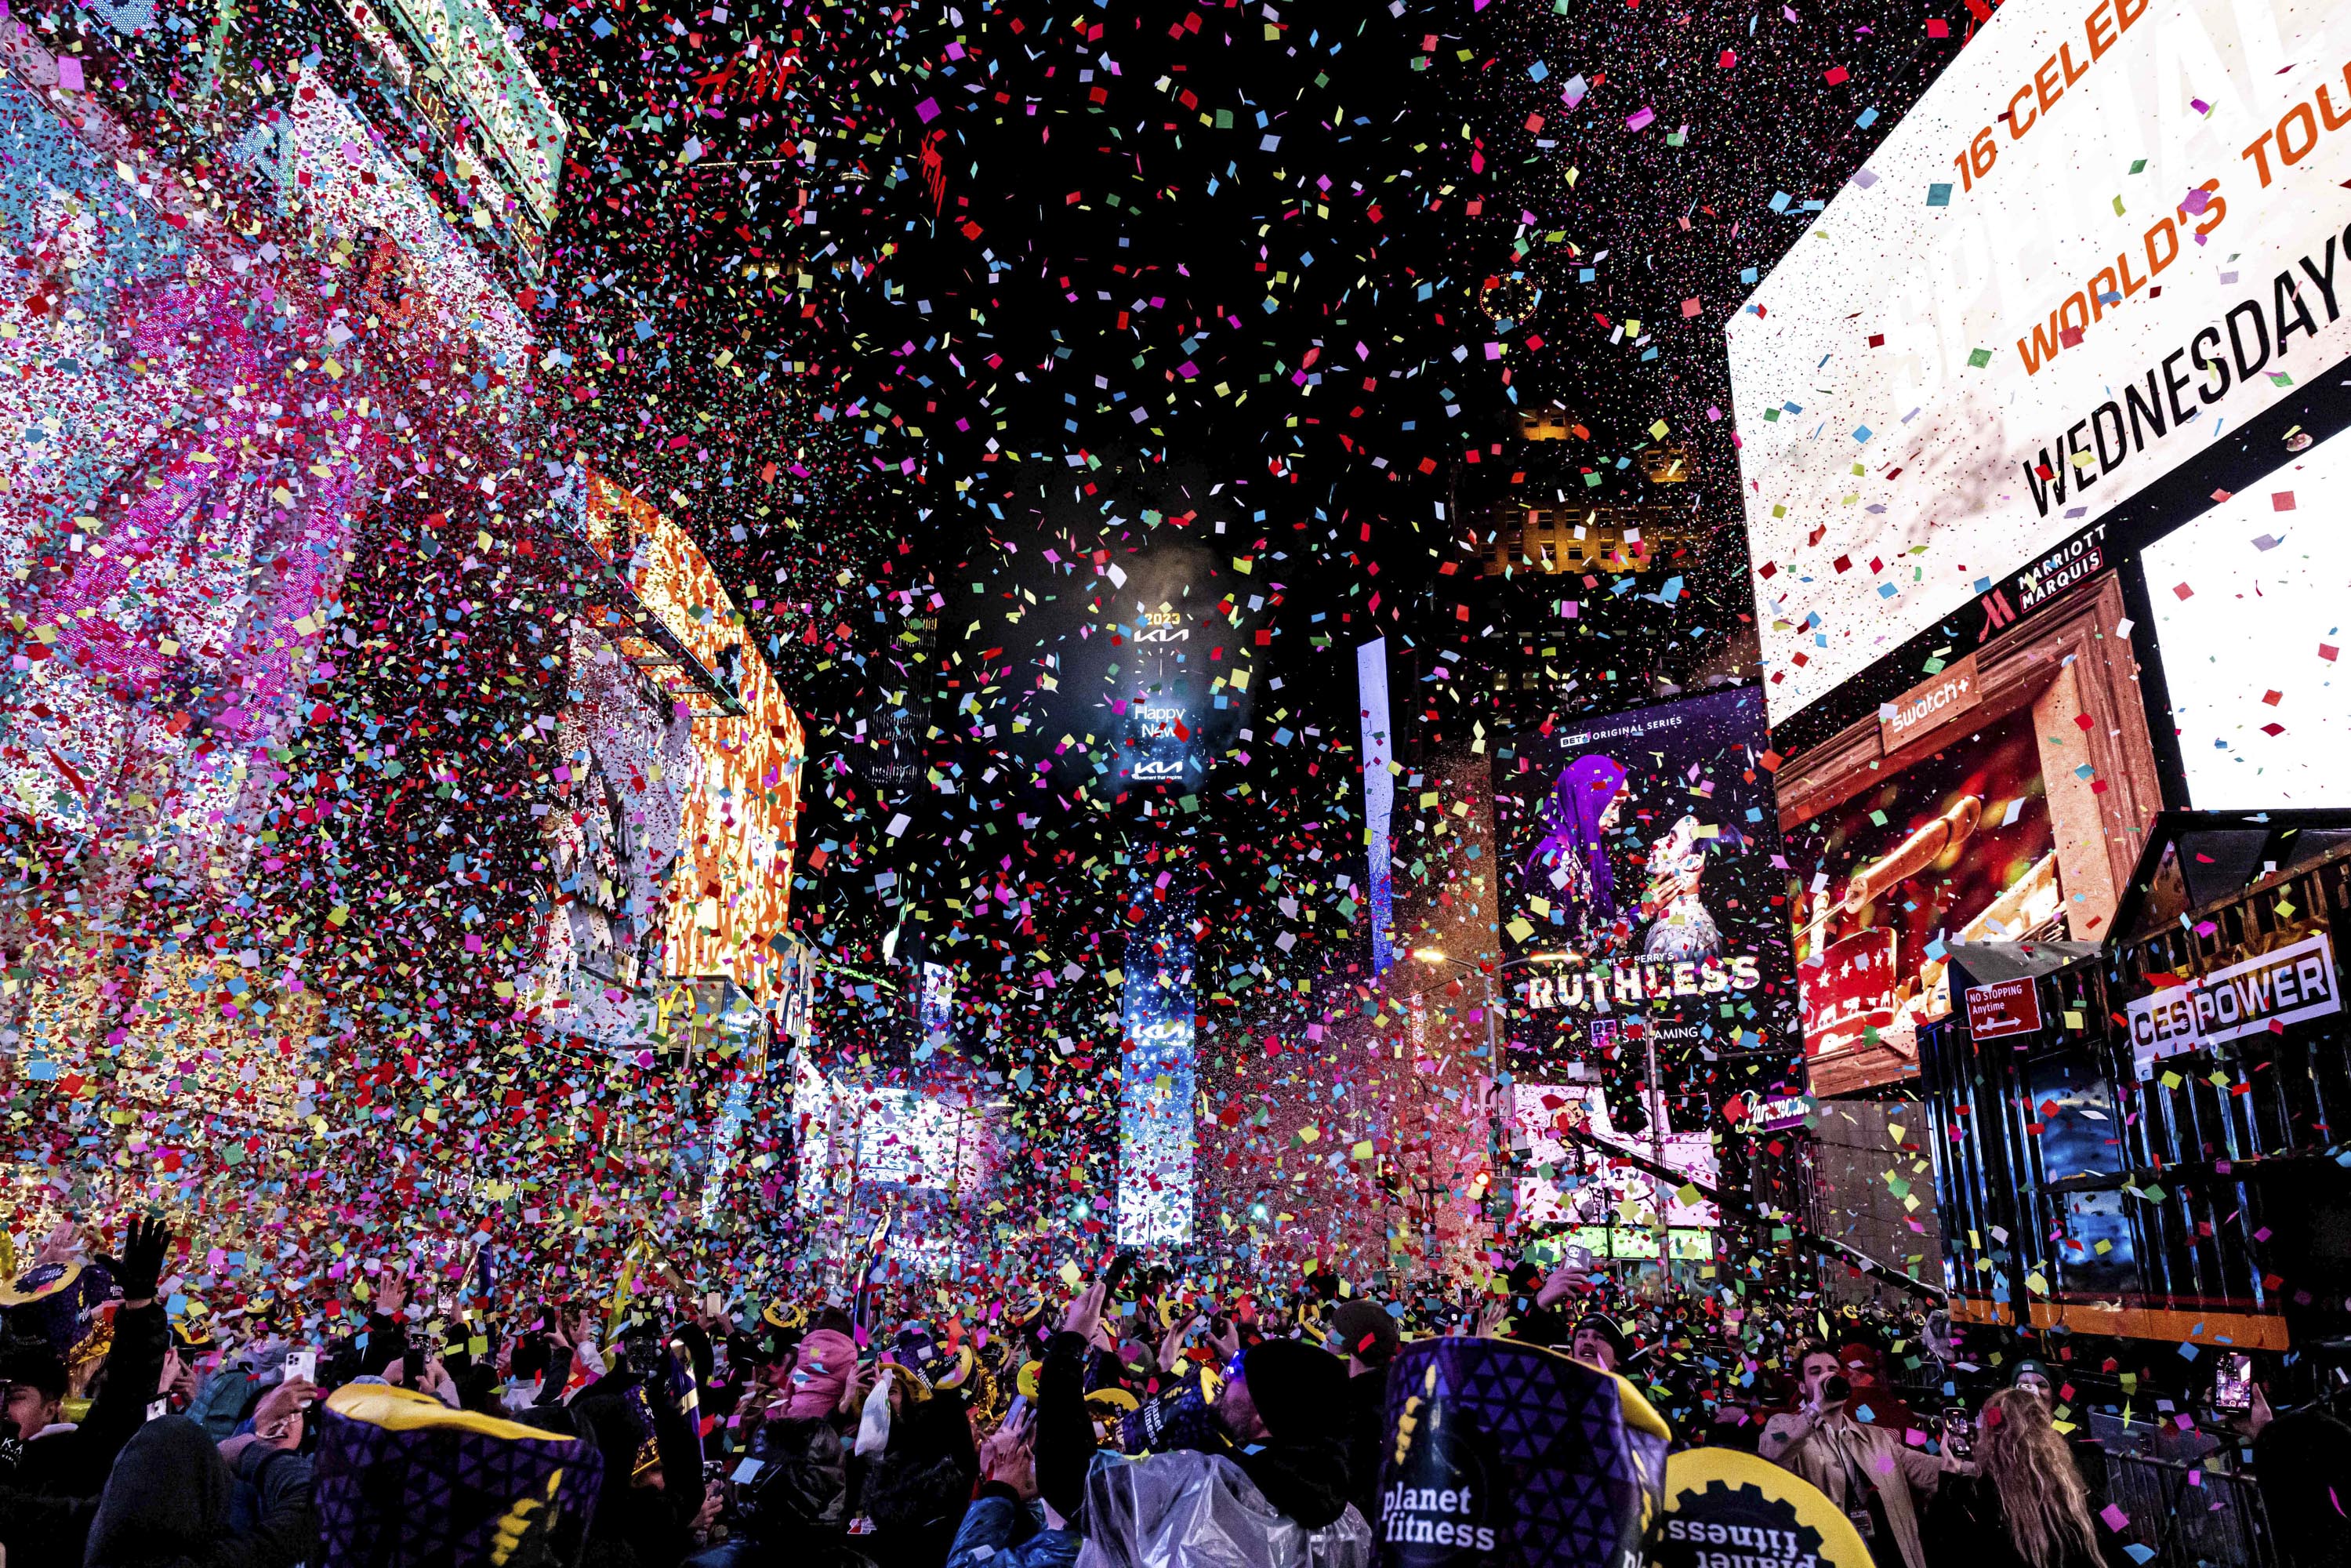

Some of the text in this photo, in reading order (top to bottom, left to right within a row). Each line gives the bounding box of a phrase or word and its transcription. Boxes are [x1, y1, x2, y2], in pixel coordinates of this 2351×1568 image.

[1954, 125, 1997, 194] 16
[2016, 178, 2226, 377] WORLD'S
[2022, 552, 2100, 610] MARQUIS
[1145, 612, 1181, 626] 2023
[1134, 705, 1187, 723] Happy
[1141, 723, 1176, 738] New
[1592, 724, 1643, 740] ORIGINAL
[1647, 716, 1682, 730] SERIES
[1634, 952, 1674, 964] PERRY'S
[1529, 956, 1761, 1009] RUTHLESS
[1969, 985, 2023, 1003] NO STOPPING
[1972, 1002, 2005, 1014] Anytime
[1144, 1406, 1159, 1446] fitness
[1149, 1397, 1164, 1432] planet
[1381, 1481, 1471, 1521] planet
[1385, 1511, 1495, 1551] fitness
[1667, 1519, 1798, 1559] fitness
